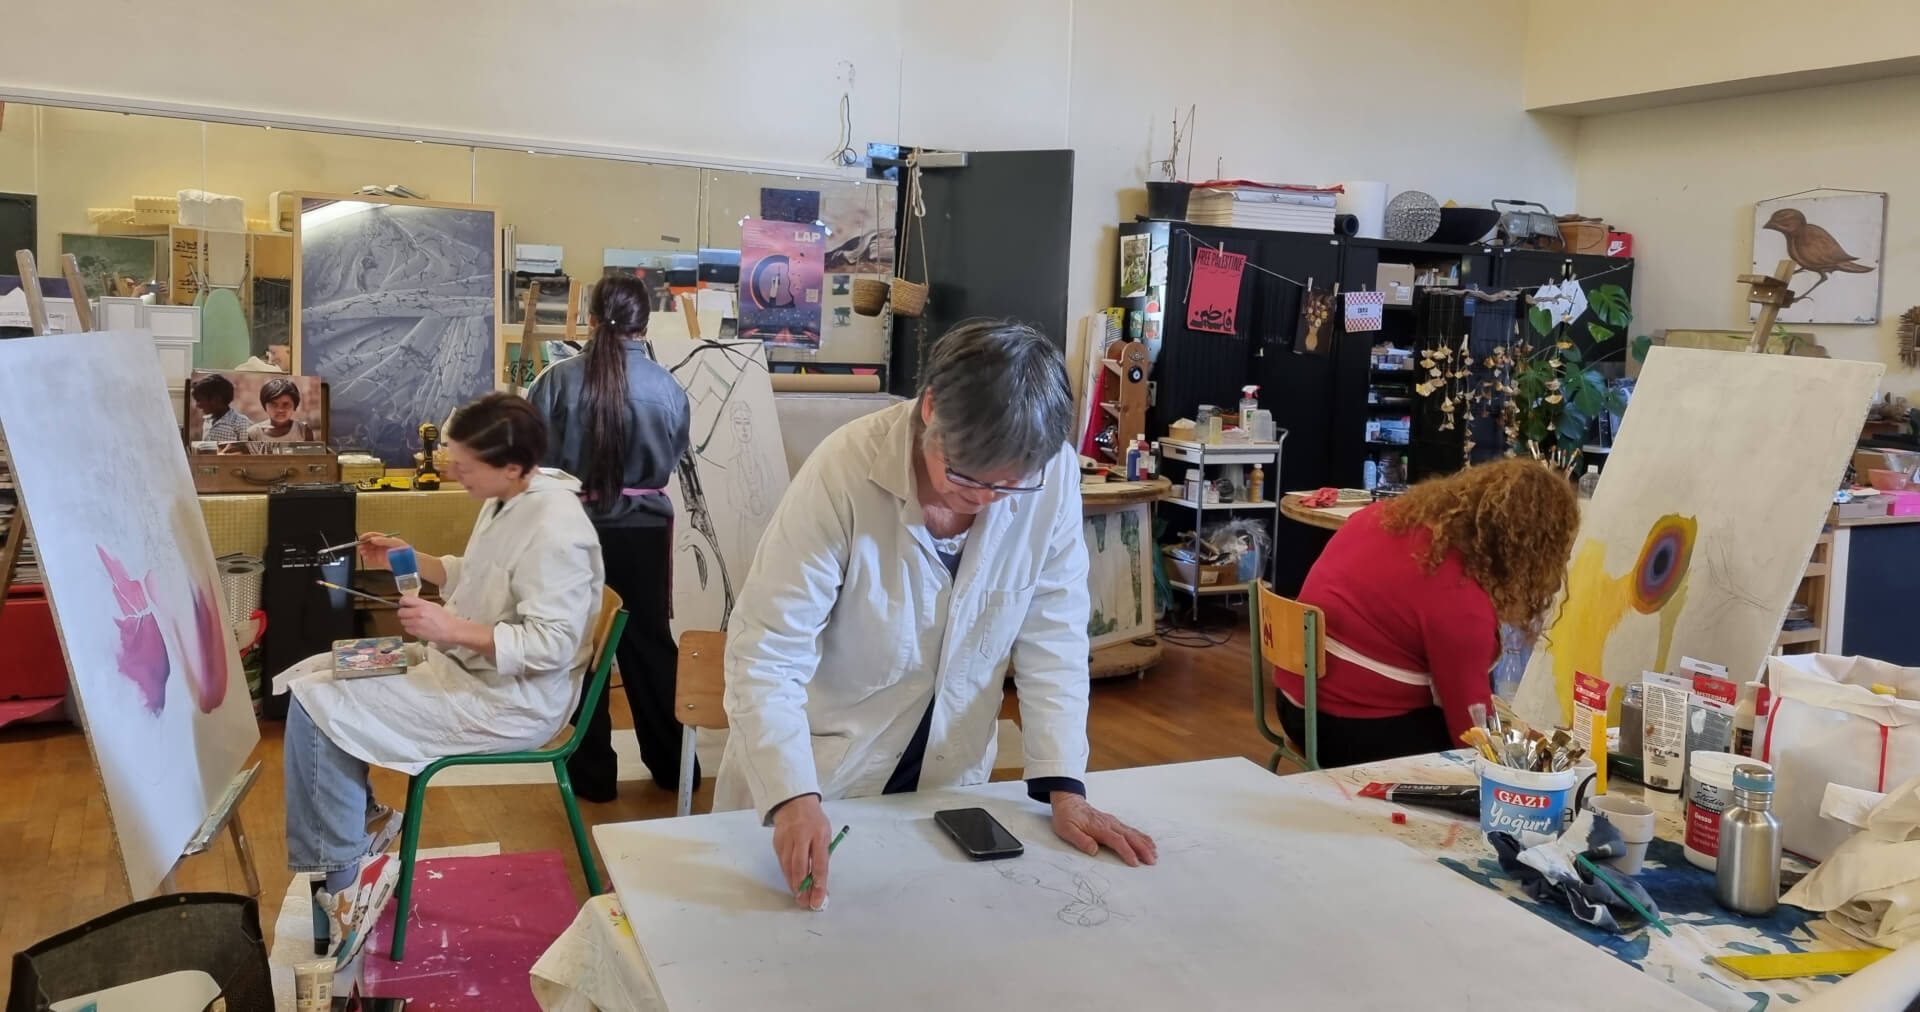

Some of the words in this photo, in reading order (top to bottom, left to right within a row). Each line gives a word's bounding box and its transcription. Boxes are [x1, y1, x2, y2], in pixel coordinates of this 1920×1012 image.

[794, 231, 821, 242] LAP
[1199, 250, 1211, 266] FREE
[1211, 252, 1244, 273] PALESTINE
[1498, 790, 1546, 808] GAZI
[1489, 800, 1552, 834] Yoğurt
[1694, 811, 1713, 824] Gesso
